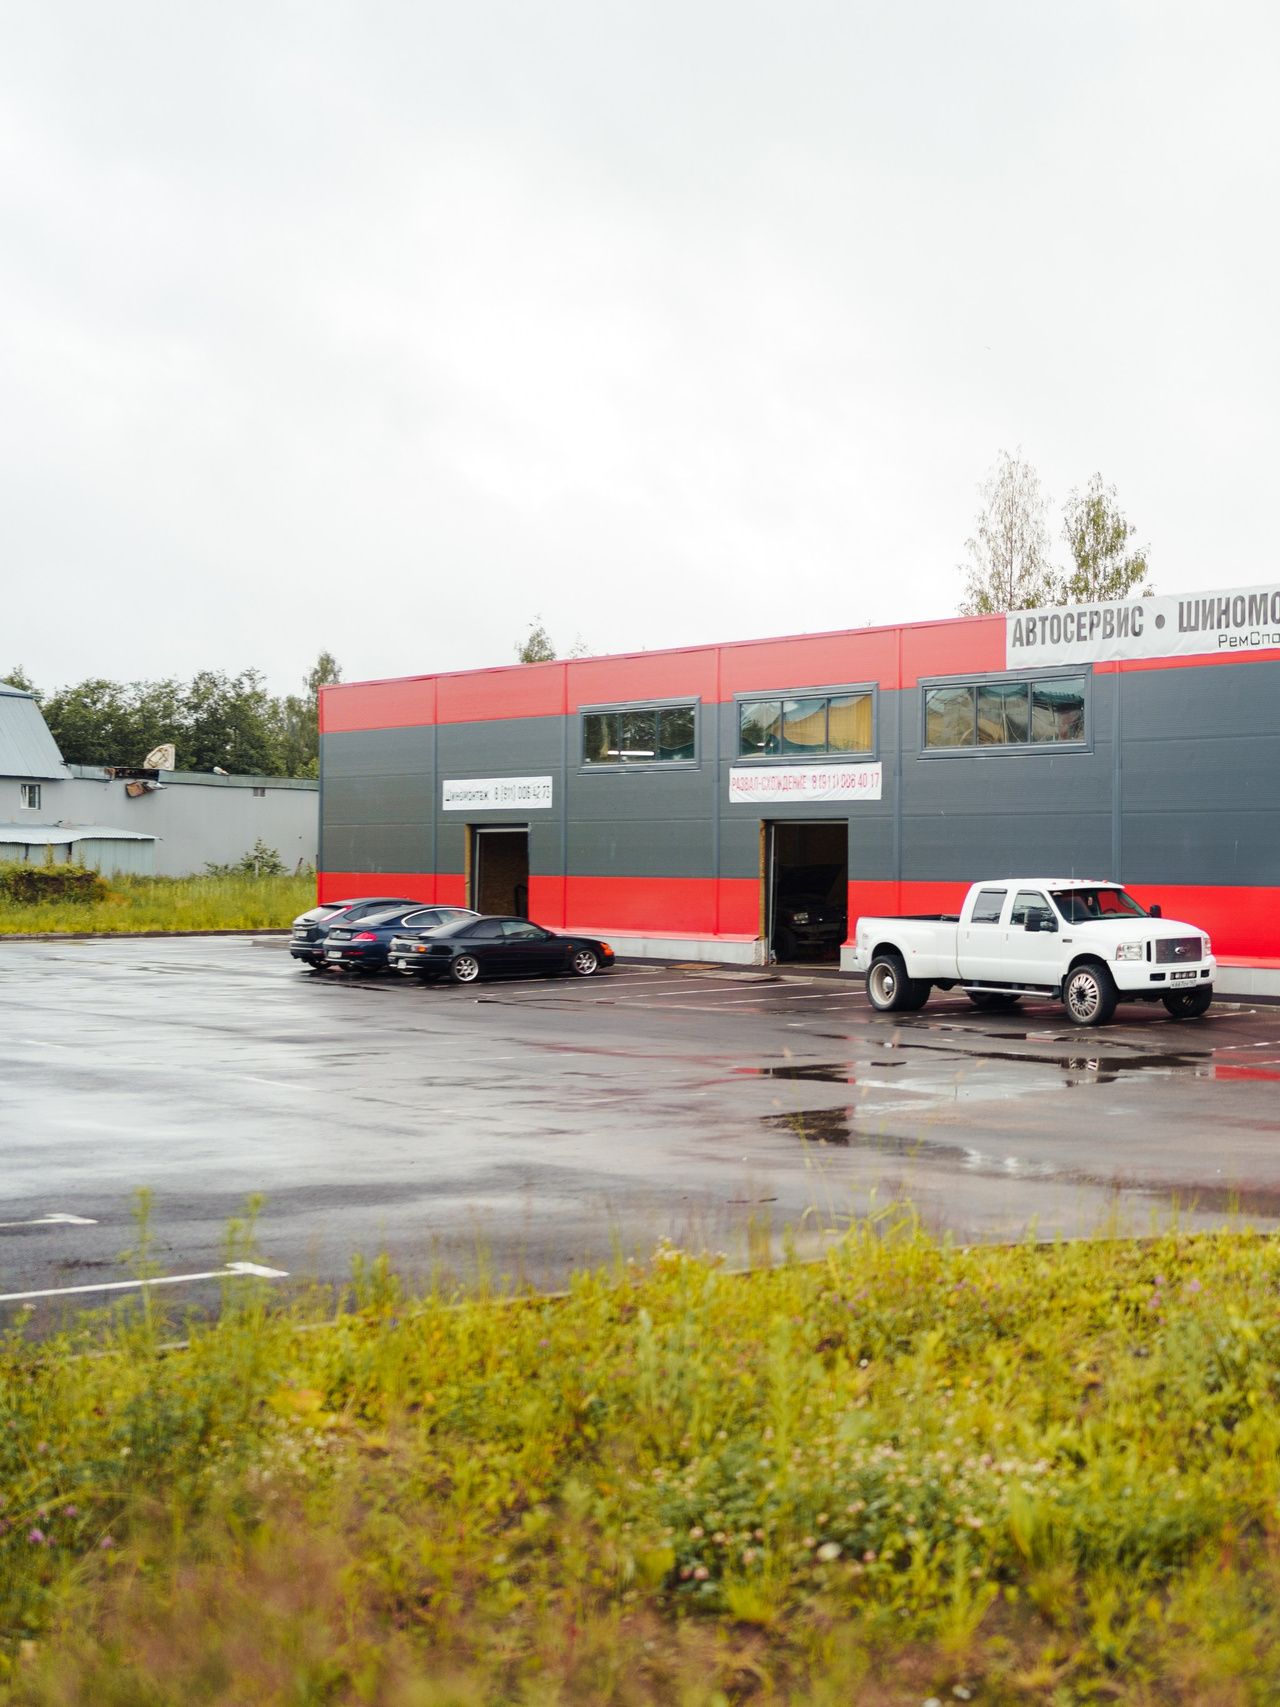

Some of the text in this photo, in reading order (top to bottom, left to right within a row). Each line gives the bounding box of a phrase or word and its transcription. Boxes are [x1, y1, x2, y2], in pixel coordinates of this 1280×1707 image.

[1011, 605, 1144, 648] АВТОСЕРВИС
[731, 775, 807, 792] РАЗВАЛ-СХОЖДЕНИЕ
[811, 775, 818, 790] 8
